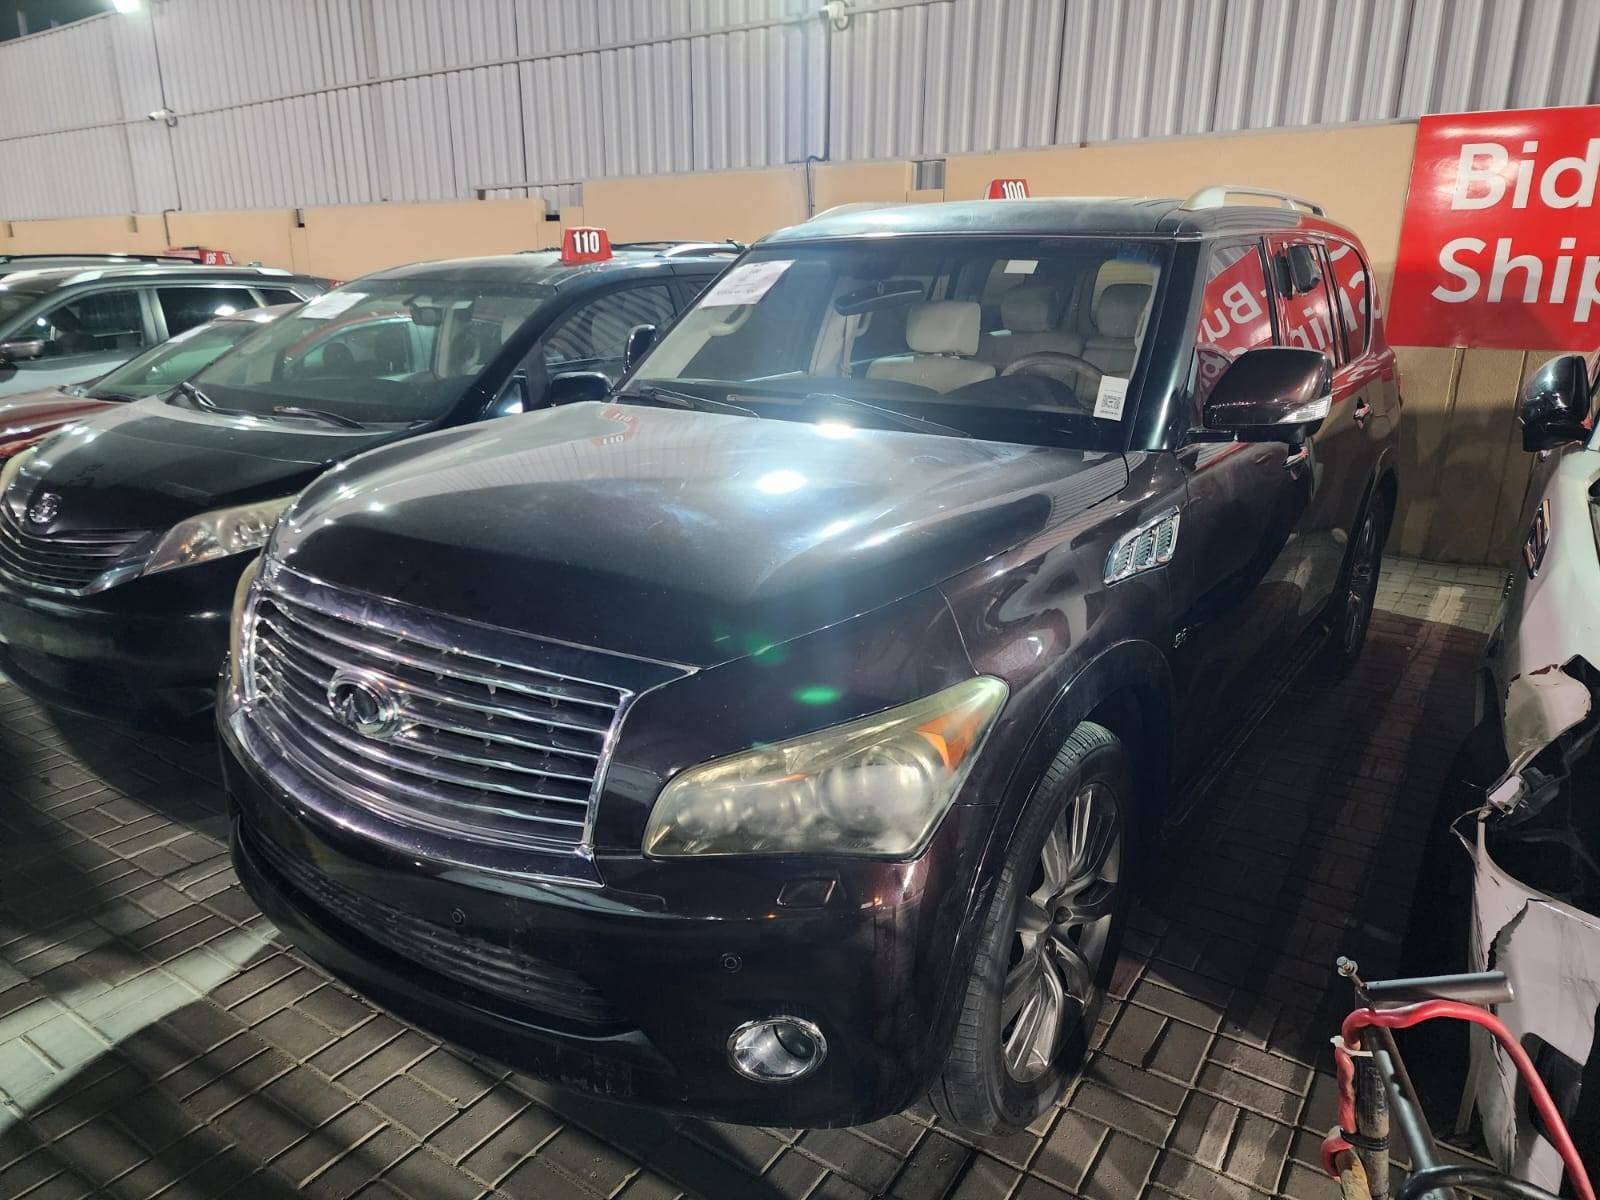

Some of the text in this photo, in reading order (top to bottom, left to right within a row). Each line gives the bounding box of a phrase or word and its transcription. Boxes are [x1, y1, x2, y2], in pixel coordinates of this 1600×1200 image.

[1451, 137, 1600, 210] Bid
[1002, 181, 1026, 201] 100
[573, 231, 600, 254] 110
